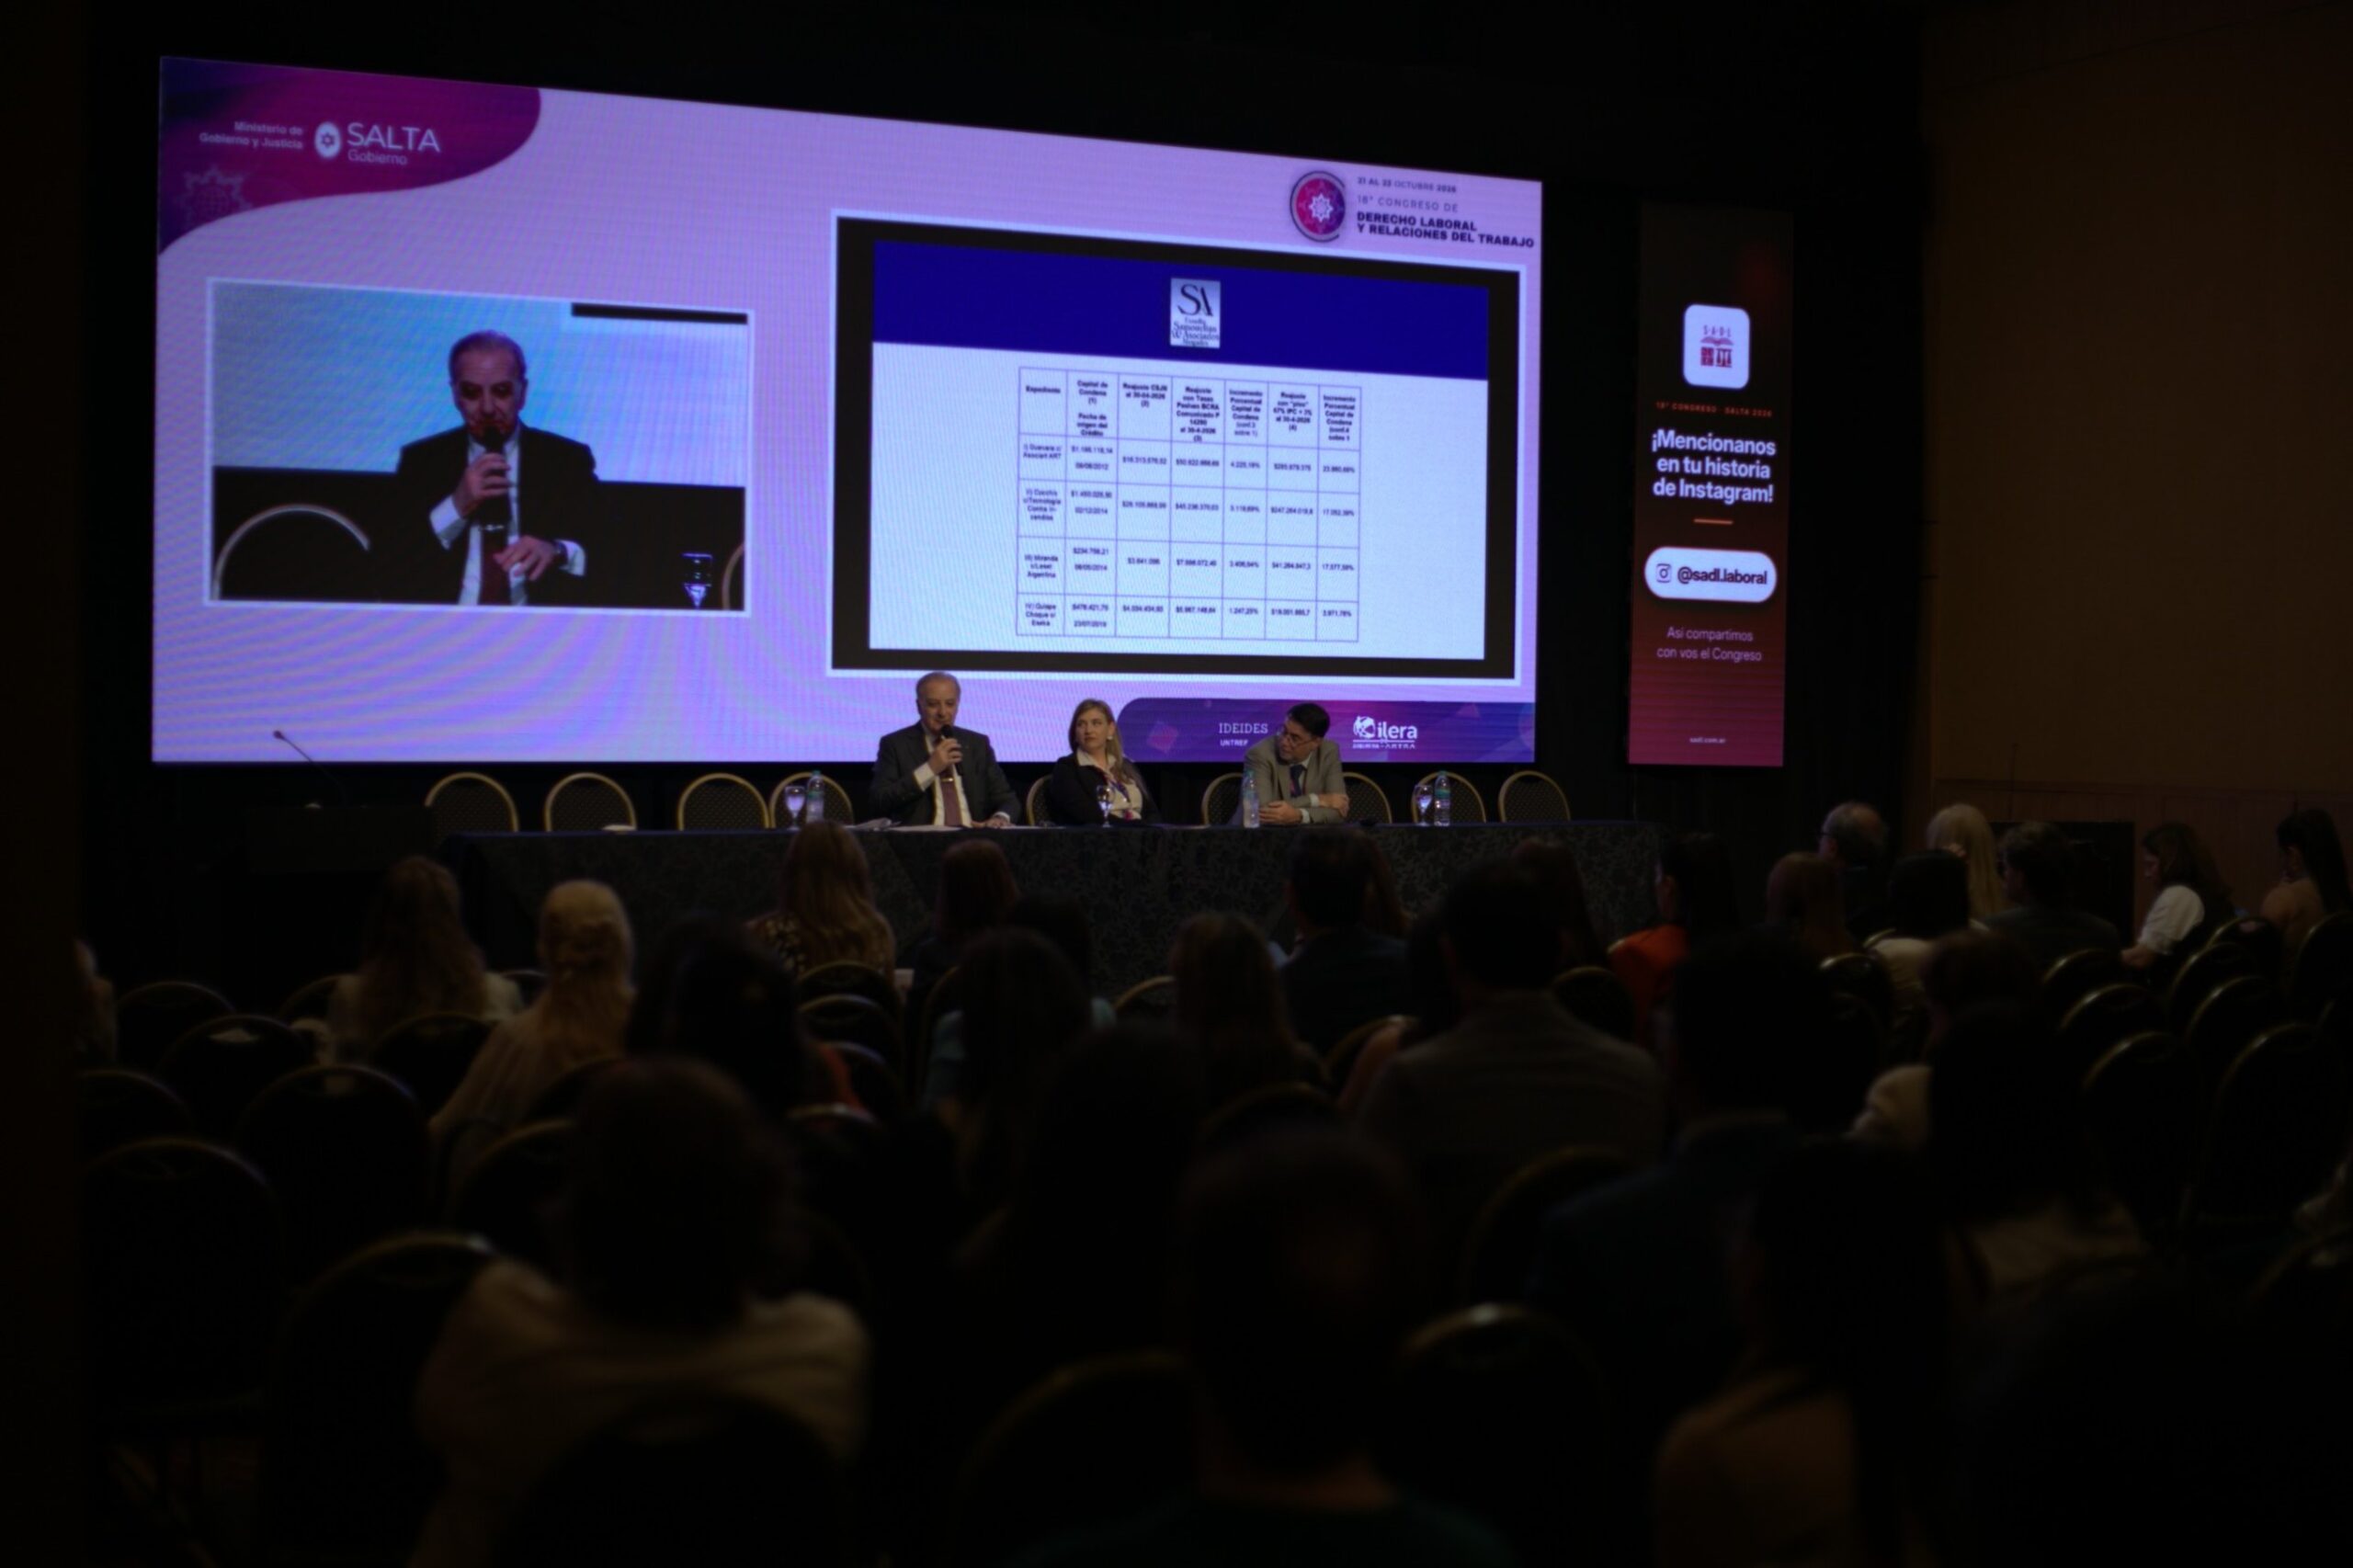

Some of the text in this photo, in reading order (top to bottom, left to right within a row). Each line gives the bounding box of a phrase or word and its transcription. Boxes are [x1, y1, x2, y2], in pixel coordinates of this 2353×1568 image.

[234, 121, 287, 134] Ministerio
[199, 132, 303, 149] Gobierno y Justicia
[347, 122, 440, 153] SALTA
[348, 149, 408, 165] Gobierno
[1394, 180, 1434, 191] OCTUBRE
[1378, 197, 1439, 211] CONGRESO
[1444, 202, 1458, 213] DE
[1358, 211, 1477, 232] DERECHO LABORAL
[1358, 223, 1535, 248] Y RELACIONES DEL TRABAJO
[1026, 385, 1061, 393] Expediente
[1077, 380, 1098, 388] Capital
[1230, 397, 1262, 405] Porcentual
[1280, 392, 1305, 400] Reajuste
[1324, 394, 1356, 403] Incremento
[1324, 403, 1355, 411] Porcentual
[1671, 403, 1717, 414] CONGRESO
[1652, 428, 1776, 457] ¡Mencionanos
[1656, 457, 1770, 480] en tu historia
[1653, 478, 1774, 505] de Instagram!
[1677, 566, 1768, 585] @sadl.laboral
[1686, 628, 1754, 643] compartimos
[1656, 647, 1762, 664] con vos el Congreso
[1219, 722, 1268, 734] IDEIDES
